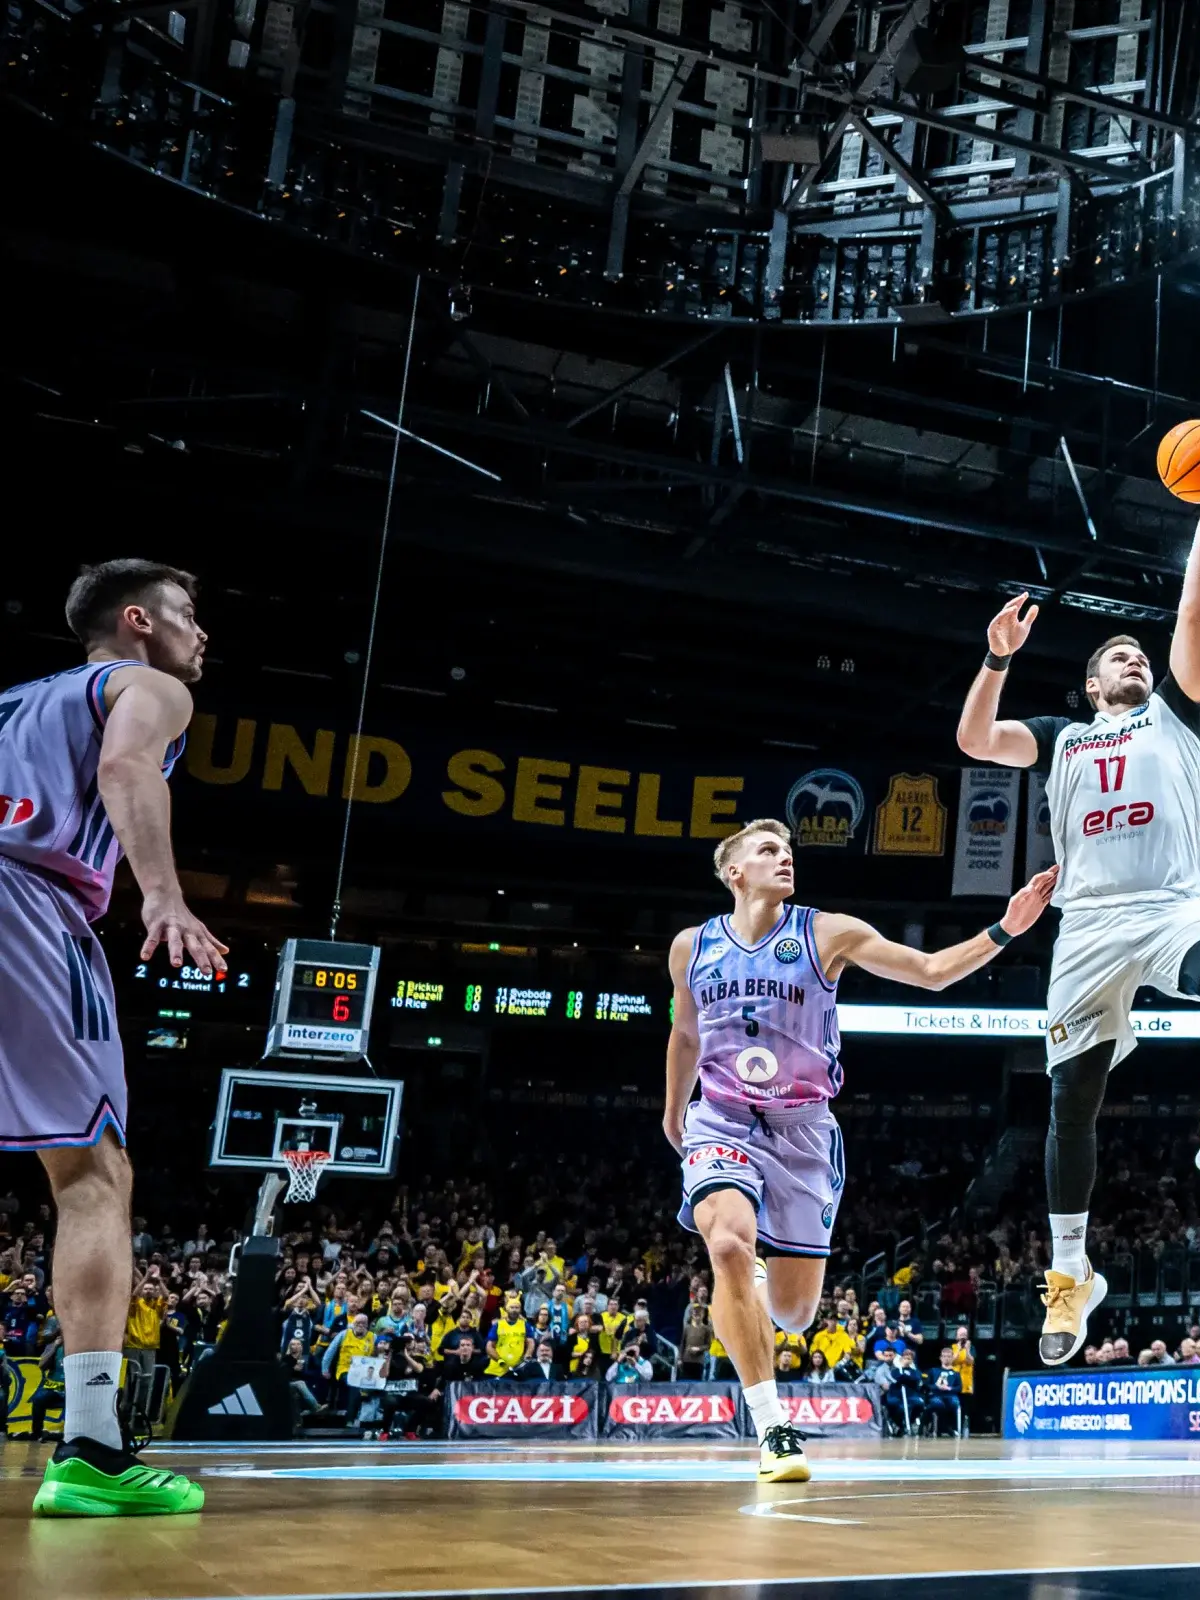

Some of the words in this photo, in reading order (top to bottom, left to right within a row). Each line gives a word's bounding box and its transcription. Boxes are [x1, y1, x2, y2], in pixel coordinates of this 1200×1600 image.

[1066, 717, 1153, 750] BASKEBALL
[186, 711, 412, 803] UND
[442, 749, 745, 838] SEELE
[1094, 755, 1126, 793] 17
[800, 815, 850, 833] ALBA
[902, 806, 923, 832] 12
[1083, 801, 1155, 836] era
[968, 860, 1000, 870] 2006
[135, 964, 147, 978] 2
[238, 973, 249, 987] 2
[159, 978, 167, 988] 0
[182, 982, 211, 992] Viertel
[218, 983, 225, 993] 1
[391, 998, 403, 1007] 10
[405, 998, 427, 1009] Rice
[510, 988, 552, 1000] Svoboda
[701, 980, 740, 1009] ALBA
[745, 979, 805, 1006] BERLIN
[333, 995, 349, 1022] 6
[742, 1006, 759, 1037] 5
[904, 1012, 965, 1028] Tickets
[970, 1014, 982, 1028] &
[288, 1025, 354, 1042] interzero
[1034, 1382, 1107, 1407] BASKETBALL
[1107, 1379, 1187, 1405] CHAMPIONS
